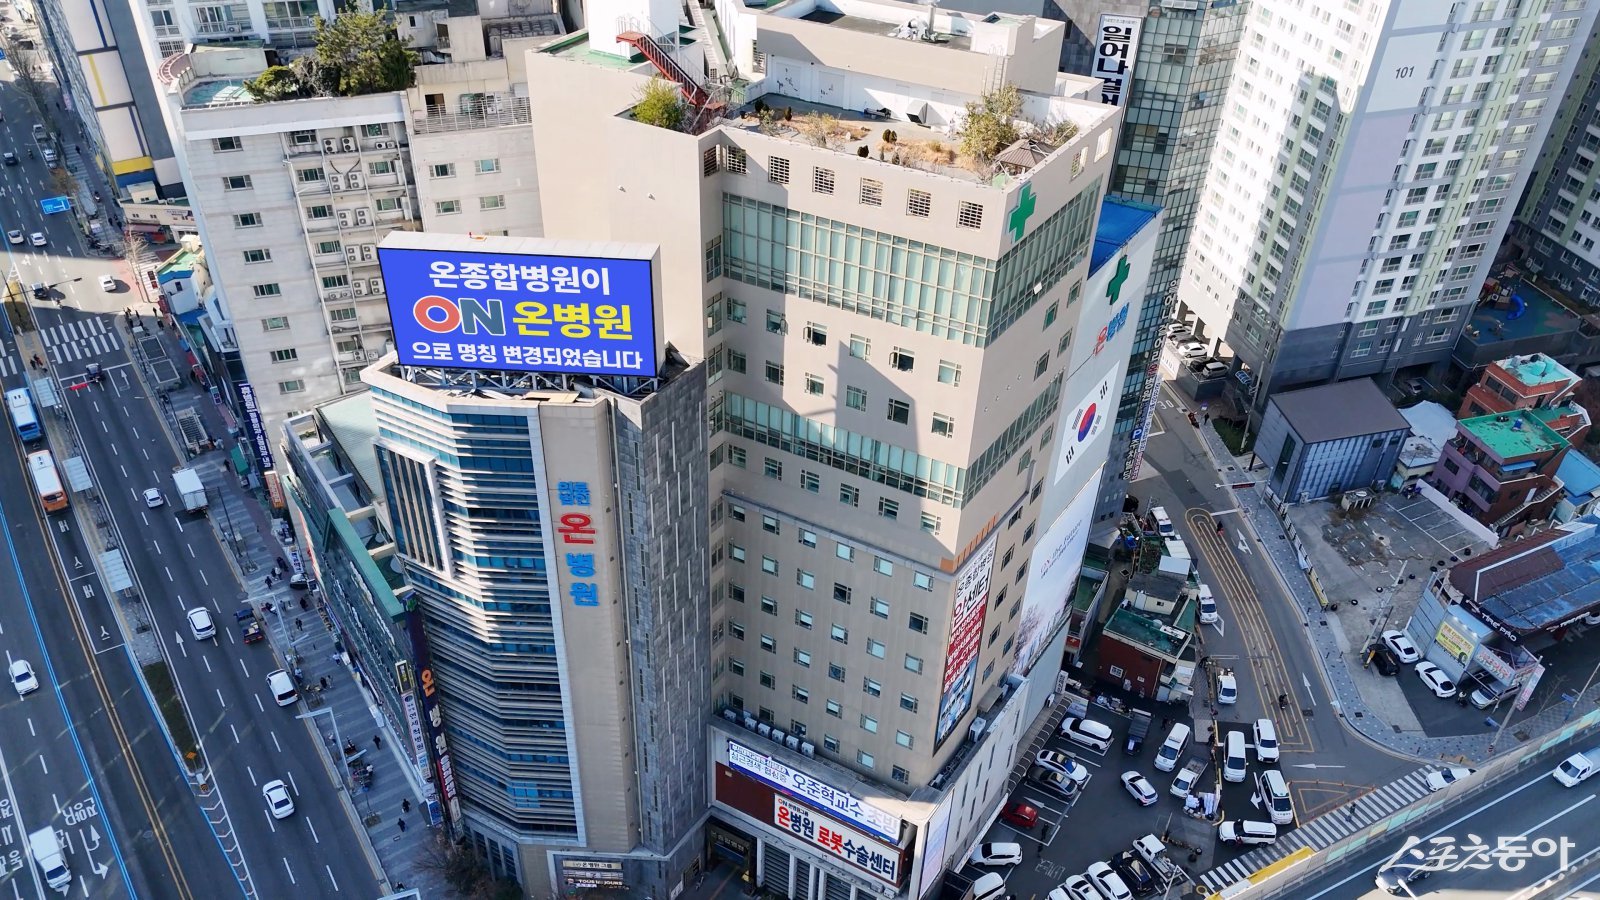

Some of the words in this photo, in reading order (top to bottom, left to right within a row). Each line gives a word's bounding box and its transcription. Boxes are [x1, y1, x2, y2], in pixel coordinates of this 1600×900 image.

[1395, 66, 1415, 79] 101
[428, 260, 611, 296] 온종합병원이
[413, 295, 506, 336] ON
[512, 301, 633, 341] 온병원
[412, 341, 453, 360] 으로
[457, 344, 497, 363] 명칭
[502, 345, 643, 370] 변경되었습니다
[1157, 399, 1174, 410] 30
[1133, 428, 1142, 439] P
[792, 773, 864, 818] 오준혁교수
[777, 805, 815, 840] 온병원
[817, 825, 896, 881] 로봇수술센터
